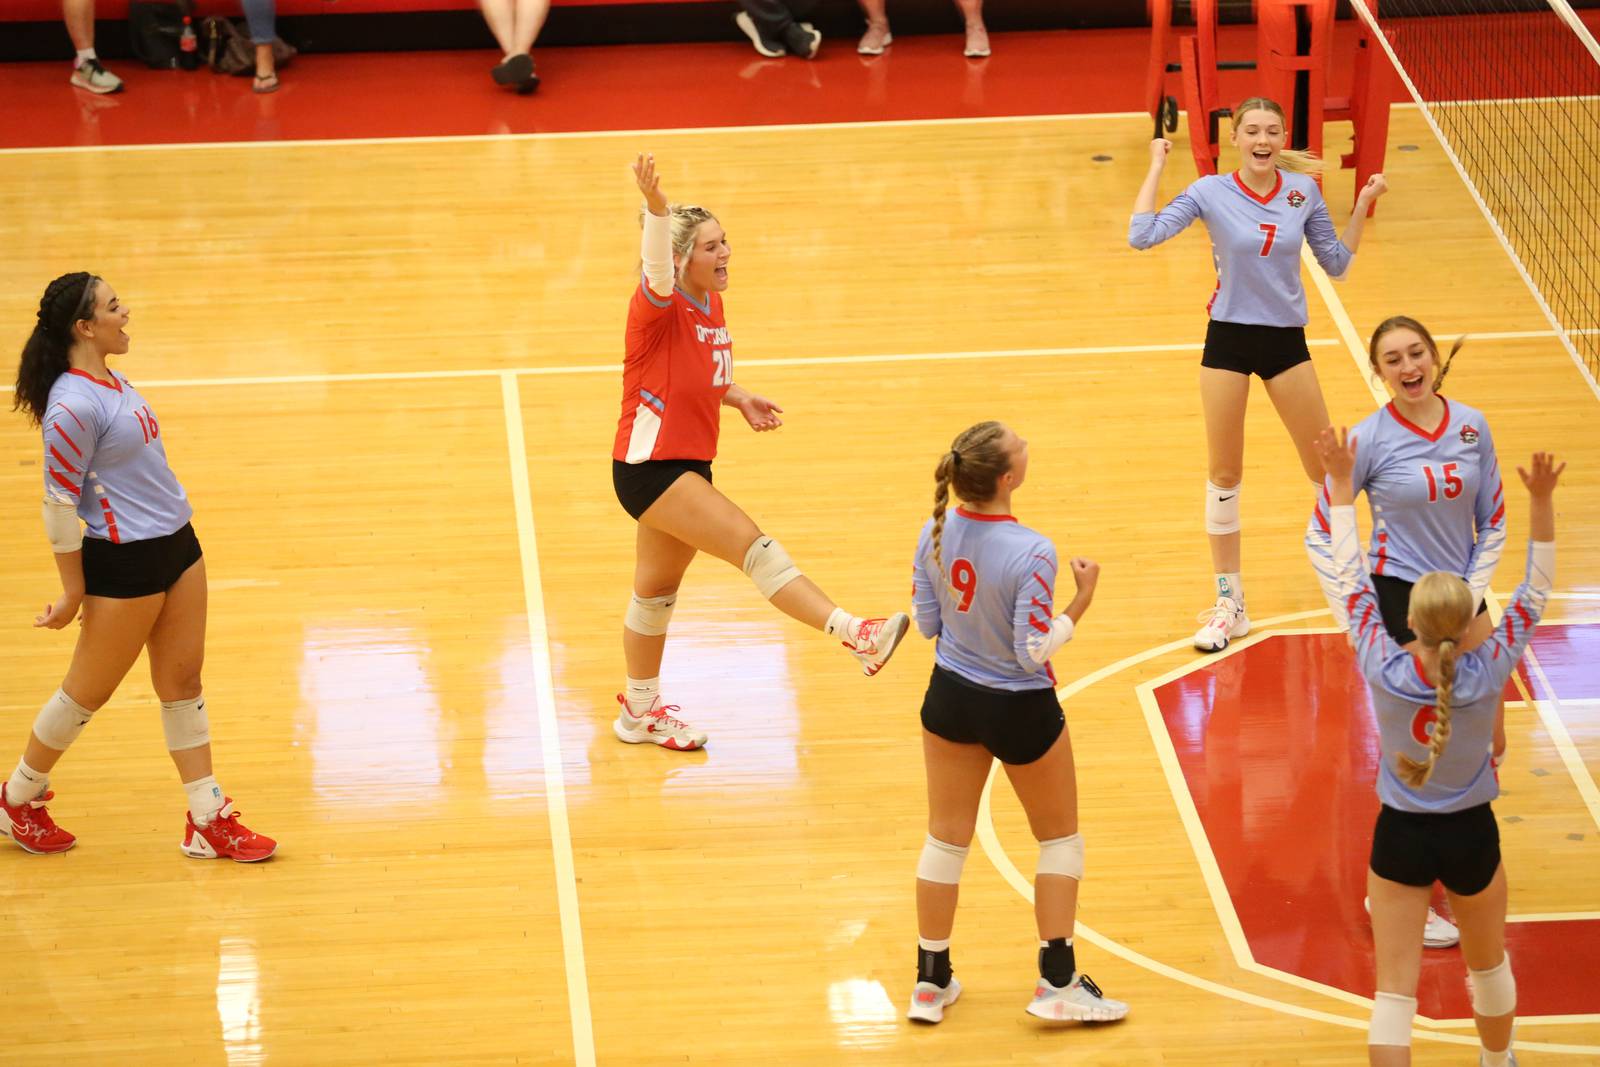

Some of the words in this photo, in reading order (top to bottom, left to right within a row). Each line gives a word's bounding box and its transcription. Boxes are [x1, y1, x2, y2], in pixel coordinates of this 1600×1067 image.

[1258, 223, 1278, 257] 7
[712, 350, 732, 387] 20
[132, 404, 159, 447] 16
[1421, 462, 1464, 503] 15
[950, 557, 977, 613] 9
